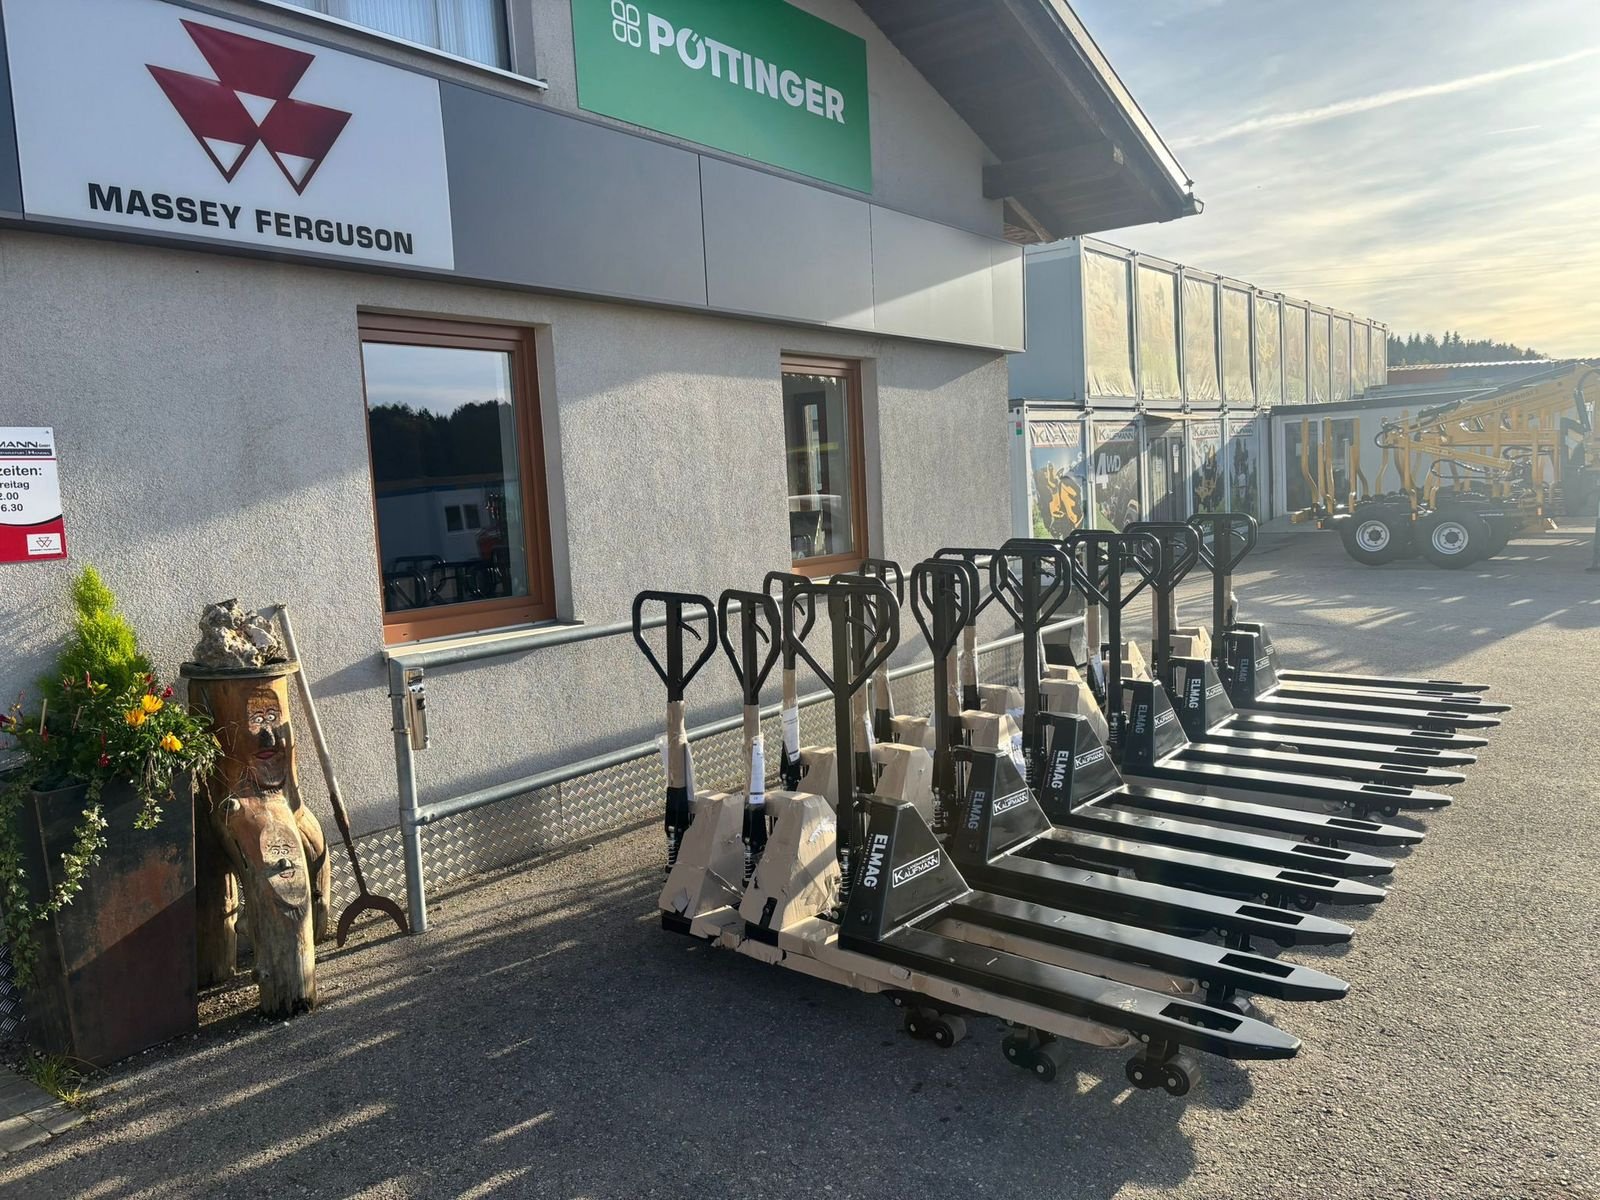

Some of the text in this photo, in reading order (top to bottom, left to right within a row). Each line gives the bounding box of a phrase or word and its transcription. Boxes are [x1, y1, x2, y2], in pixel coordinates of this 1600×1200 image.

[88, 182, 413, 254] MASSEY FERGUSON
[1188, 678, 1201, 708] ELMAG
[1135, 704, 1148, 734] ELMAG
[1051, 750, 1069, 789] ELMAG
[968, 791, 985, 829] ELMAG
[864, 834, 888, 888] ELMAG
[894, 857, 938, 883] KAUFMANN
